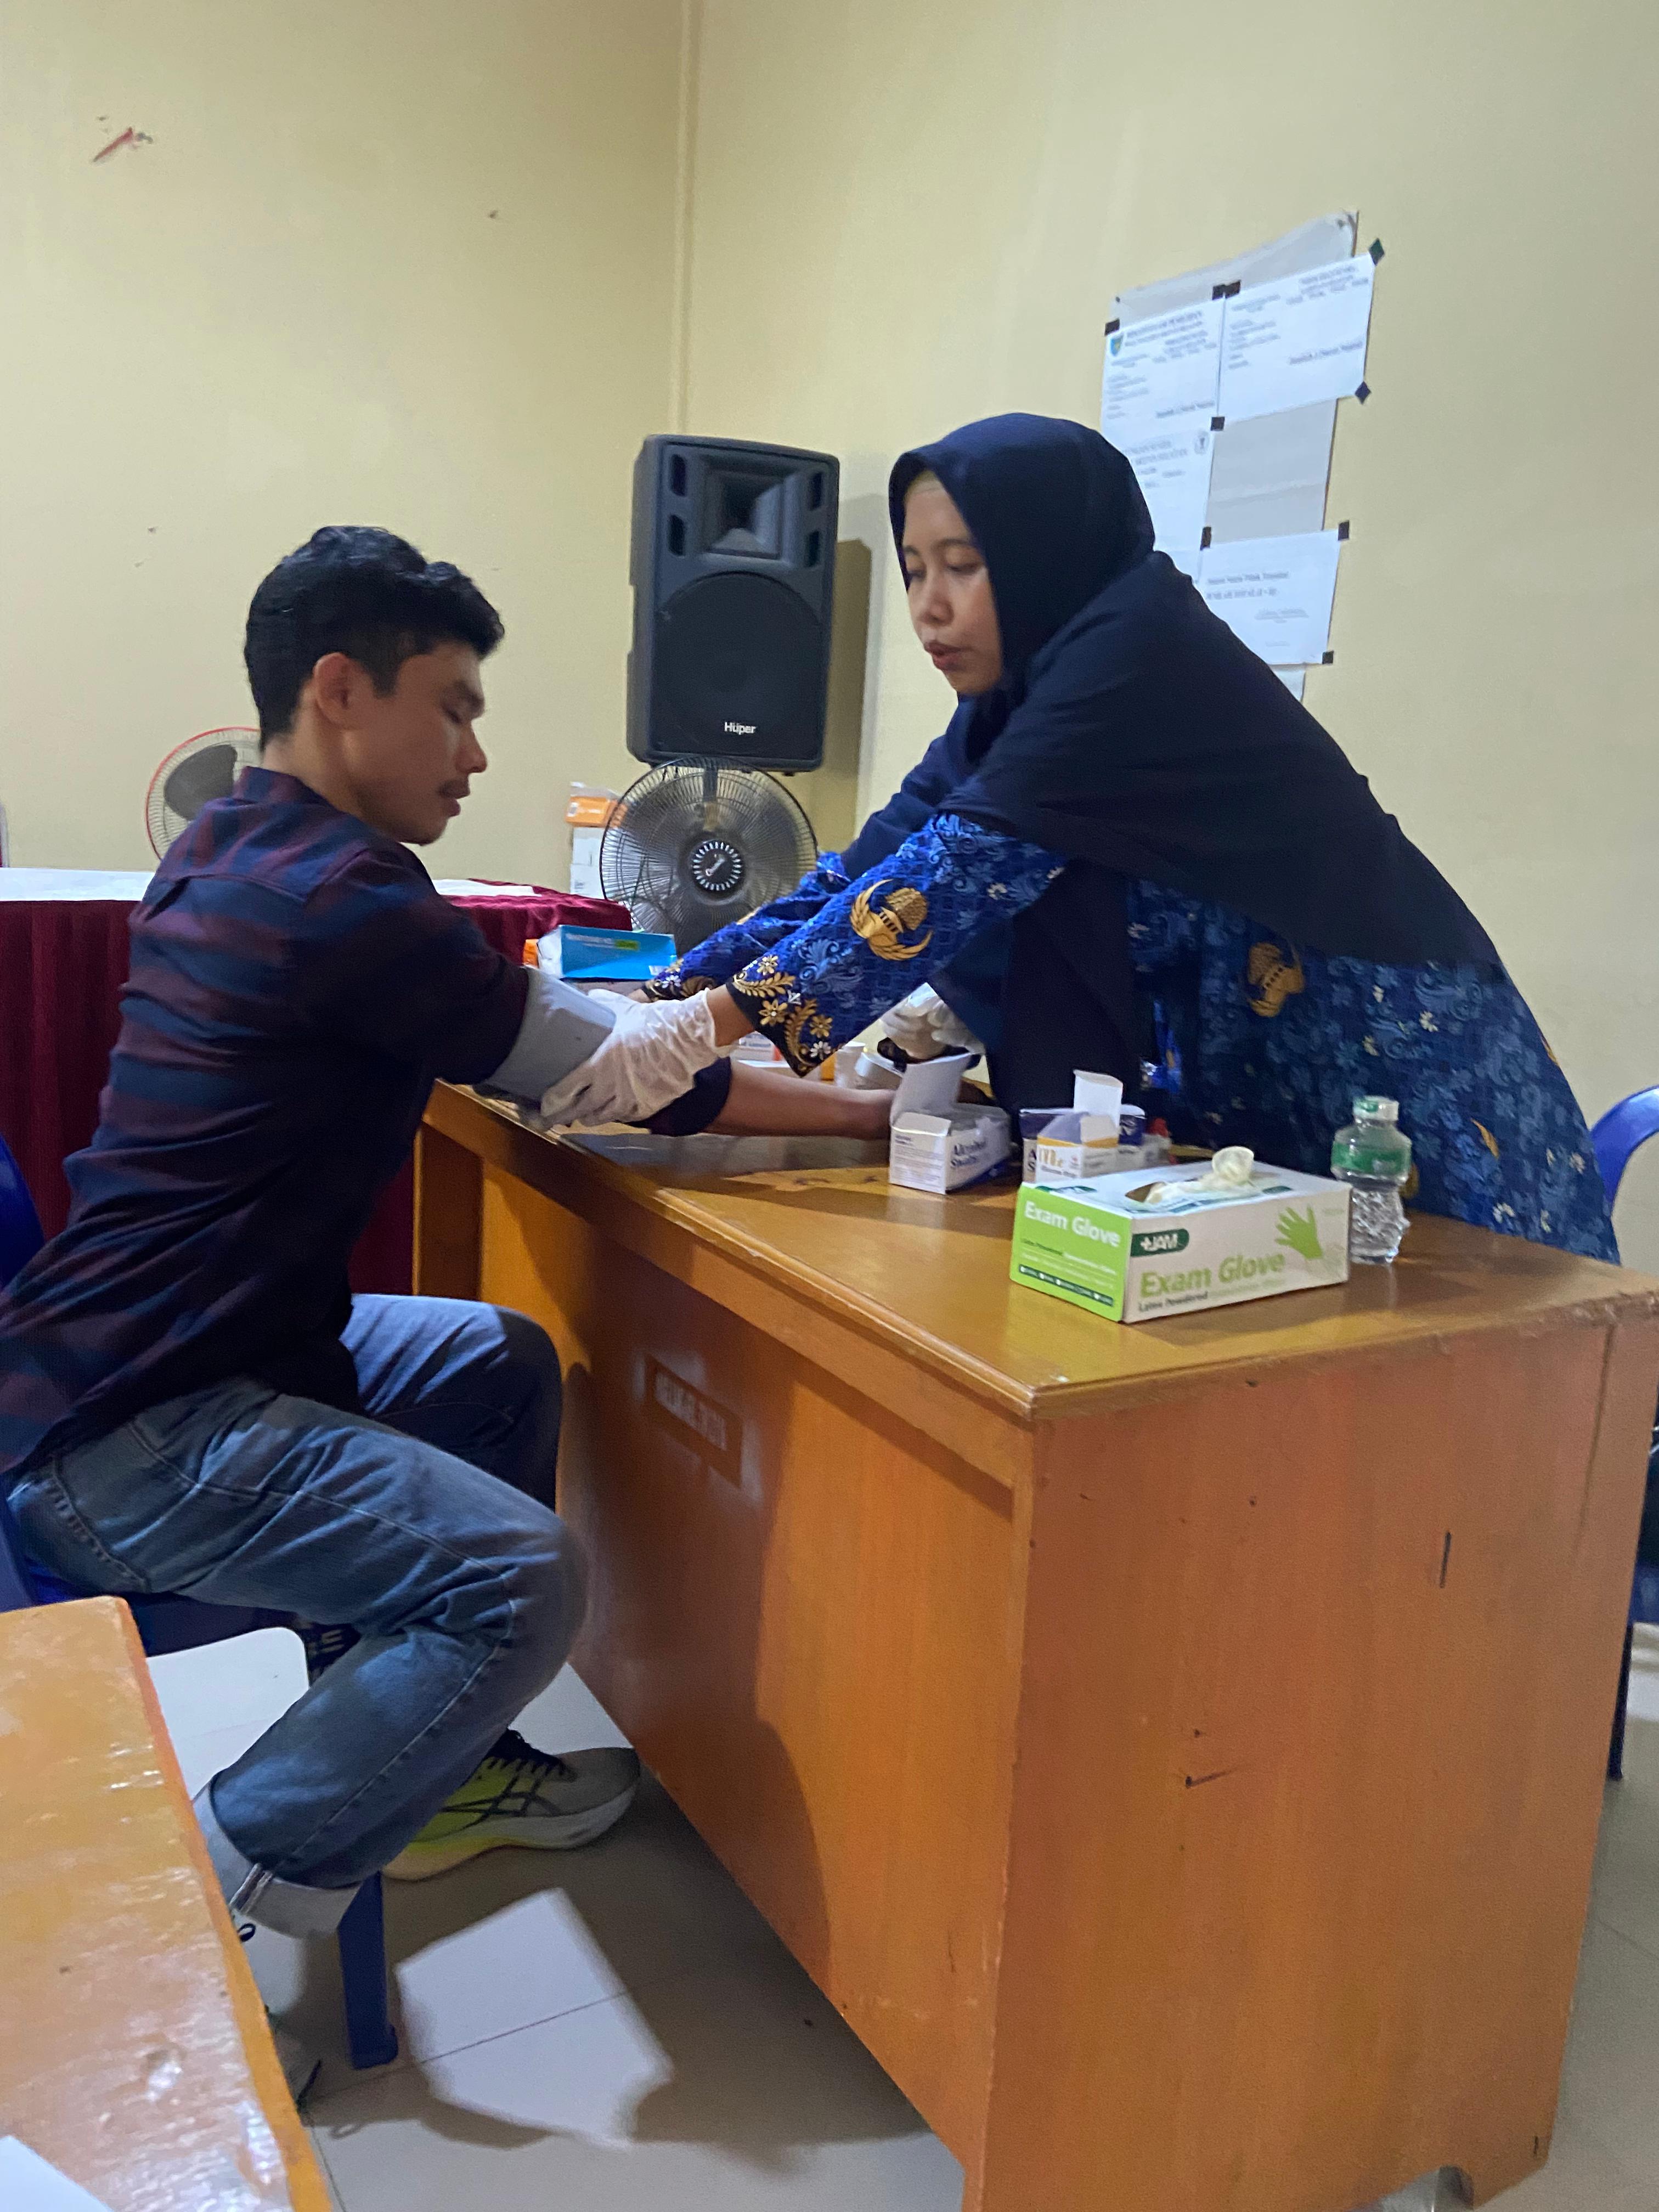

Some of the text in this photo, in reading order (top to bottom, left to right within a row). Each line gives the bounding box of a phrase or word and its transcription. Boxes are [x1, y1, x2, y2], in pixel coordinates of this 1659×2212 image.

[724, 721, 757, 735] Hüper
[1024, 1200, 1068, 1230] Exam
[1071, 1216, 1120, 1248] Glove
[1140, 1268, 1212, 1298] Exam
[1218, 1253, 1285, 1283] Glove
